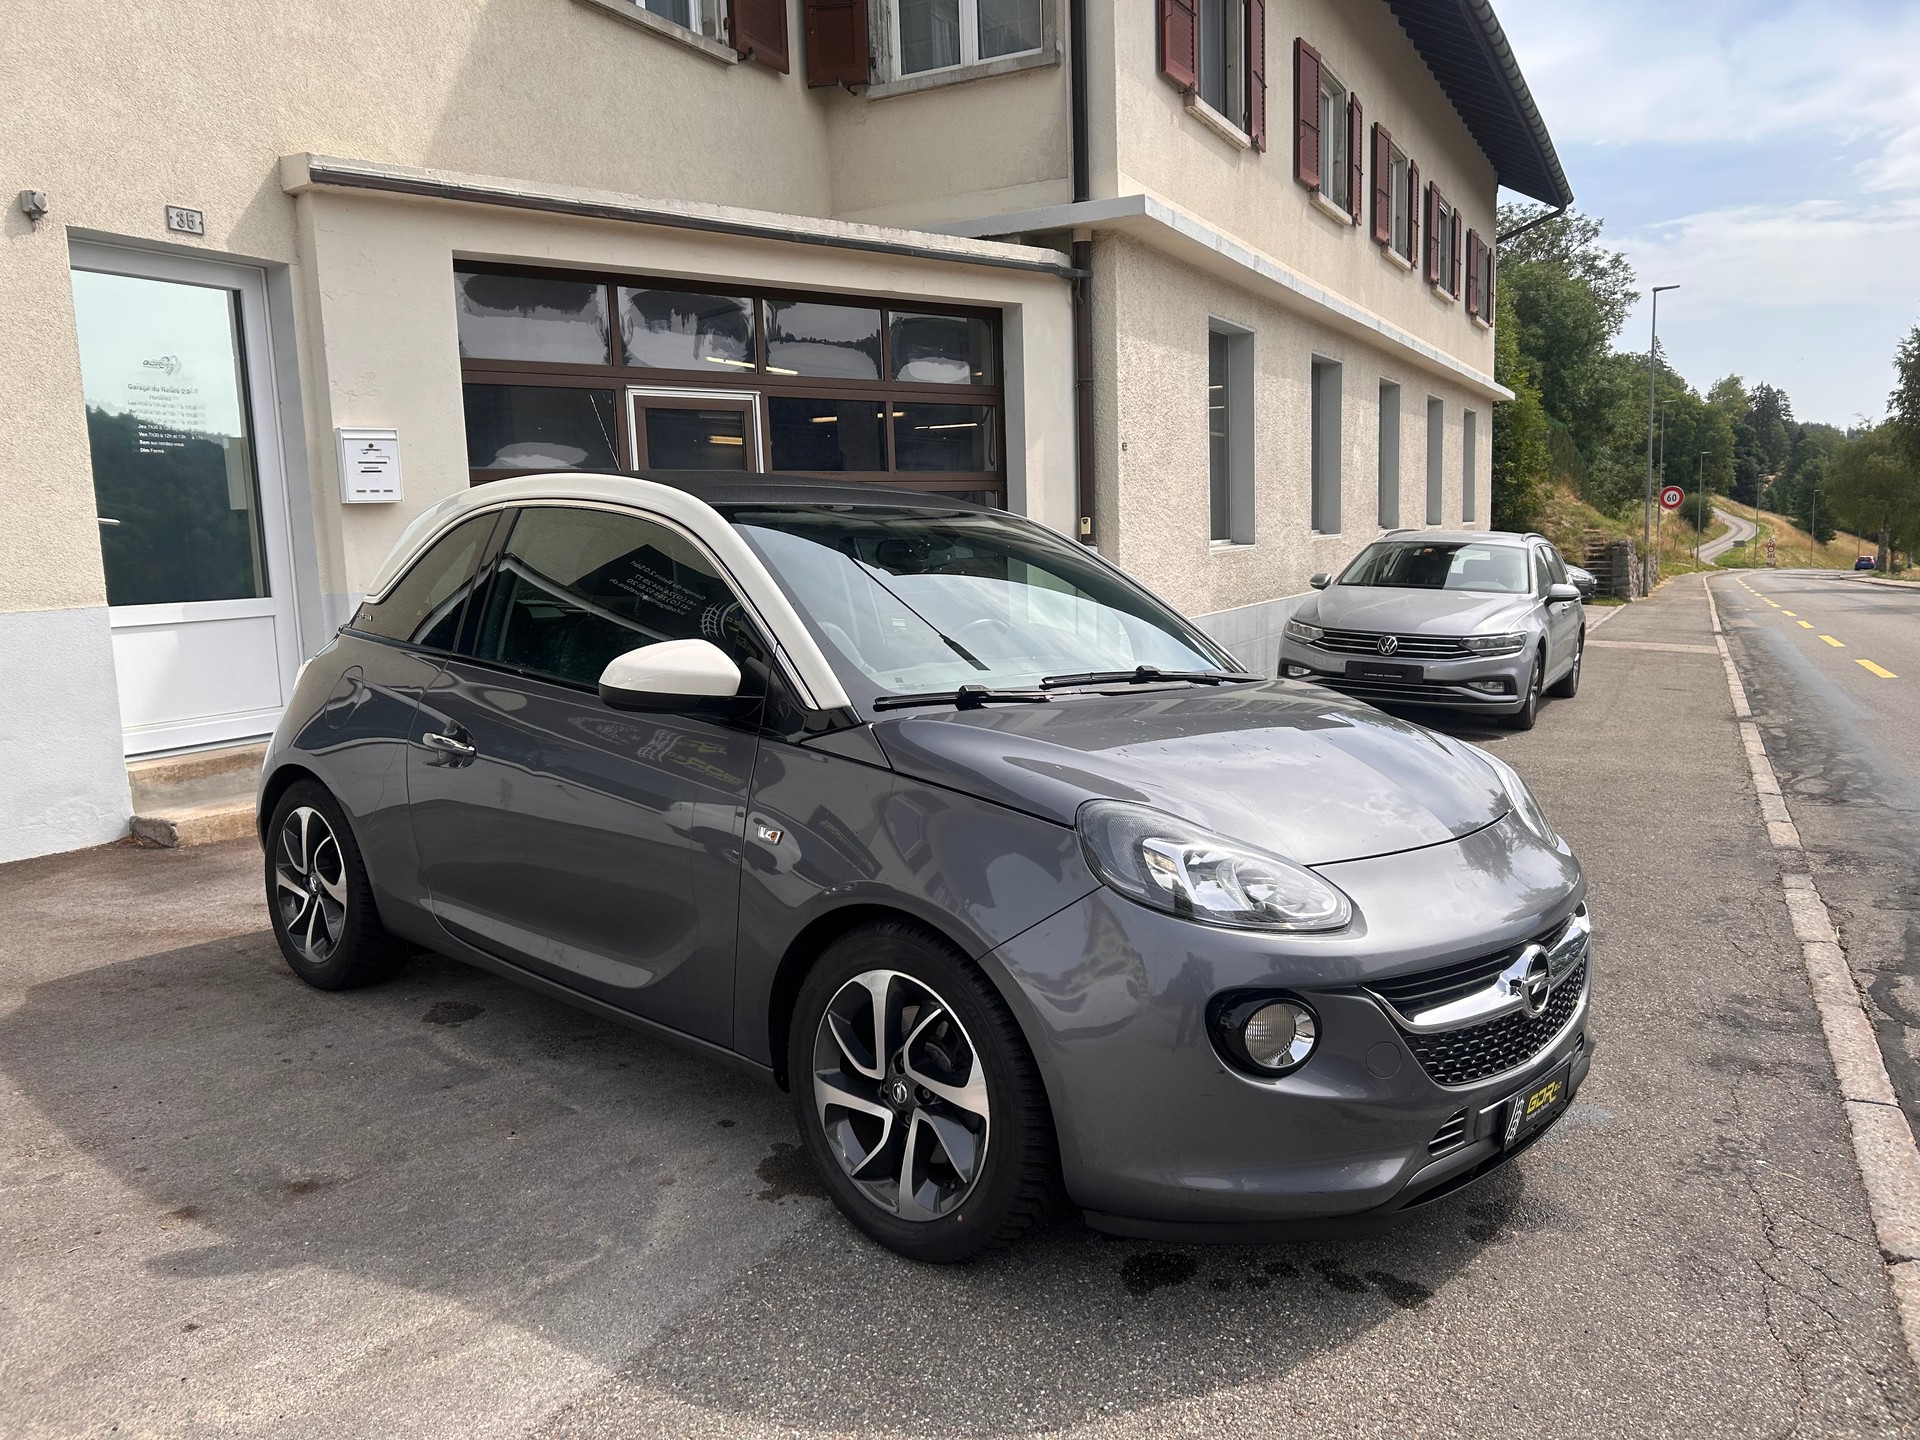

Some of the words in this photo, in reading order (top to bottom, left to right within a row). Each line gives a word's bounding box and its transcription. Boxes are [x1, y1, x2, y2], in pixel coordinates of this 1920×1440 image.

[176, 211, 196, 230] 35
[128, 384, 150, 392] Garage
[1666, 493, 1677, 502] 60
